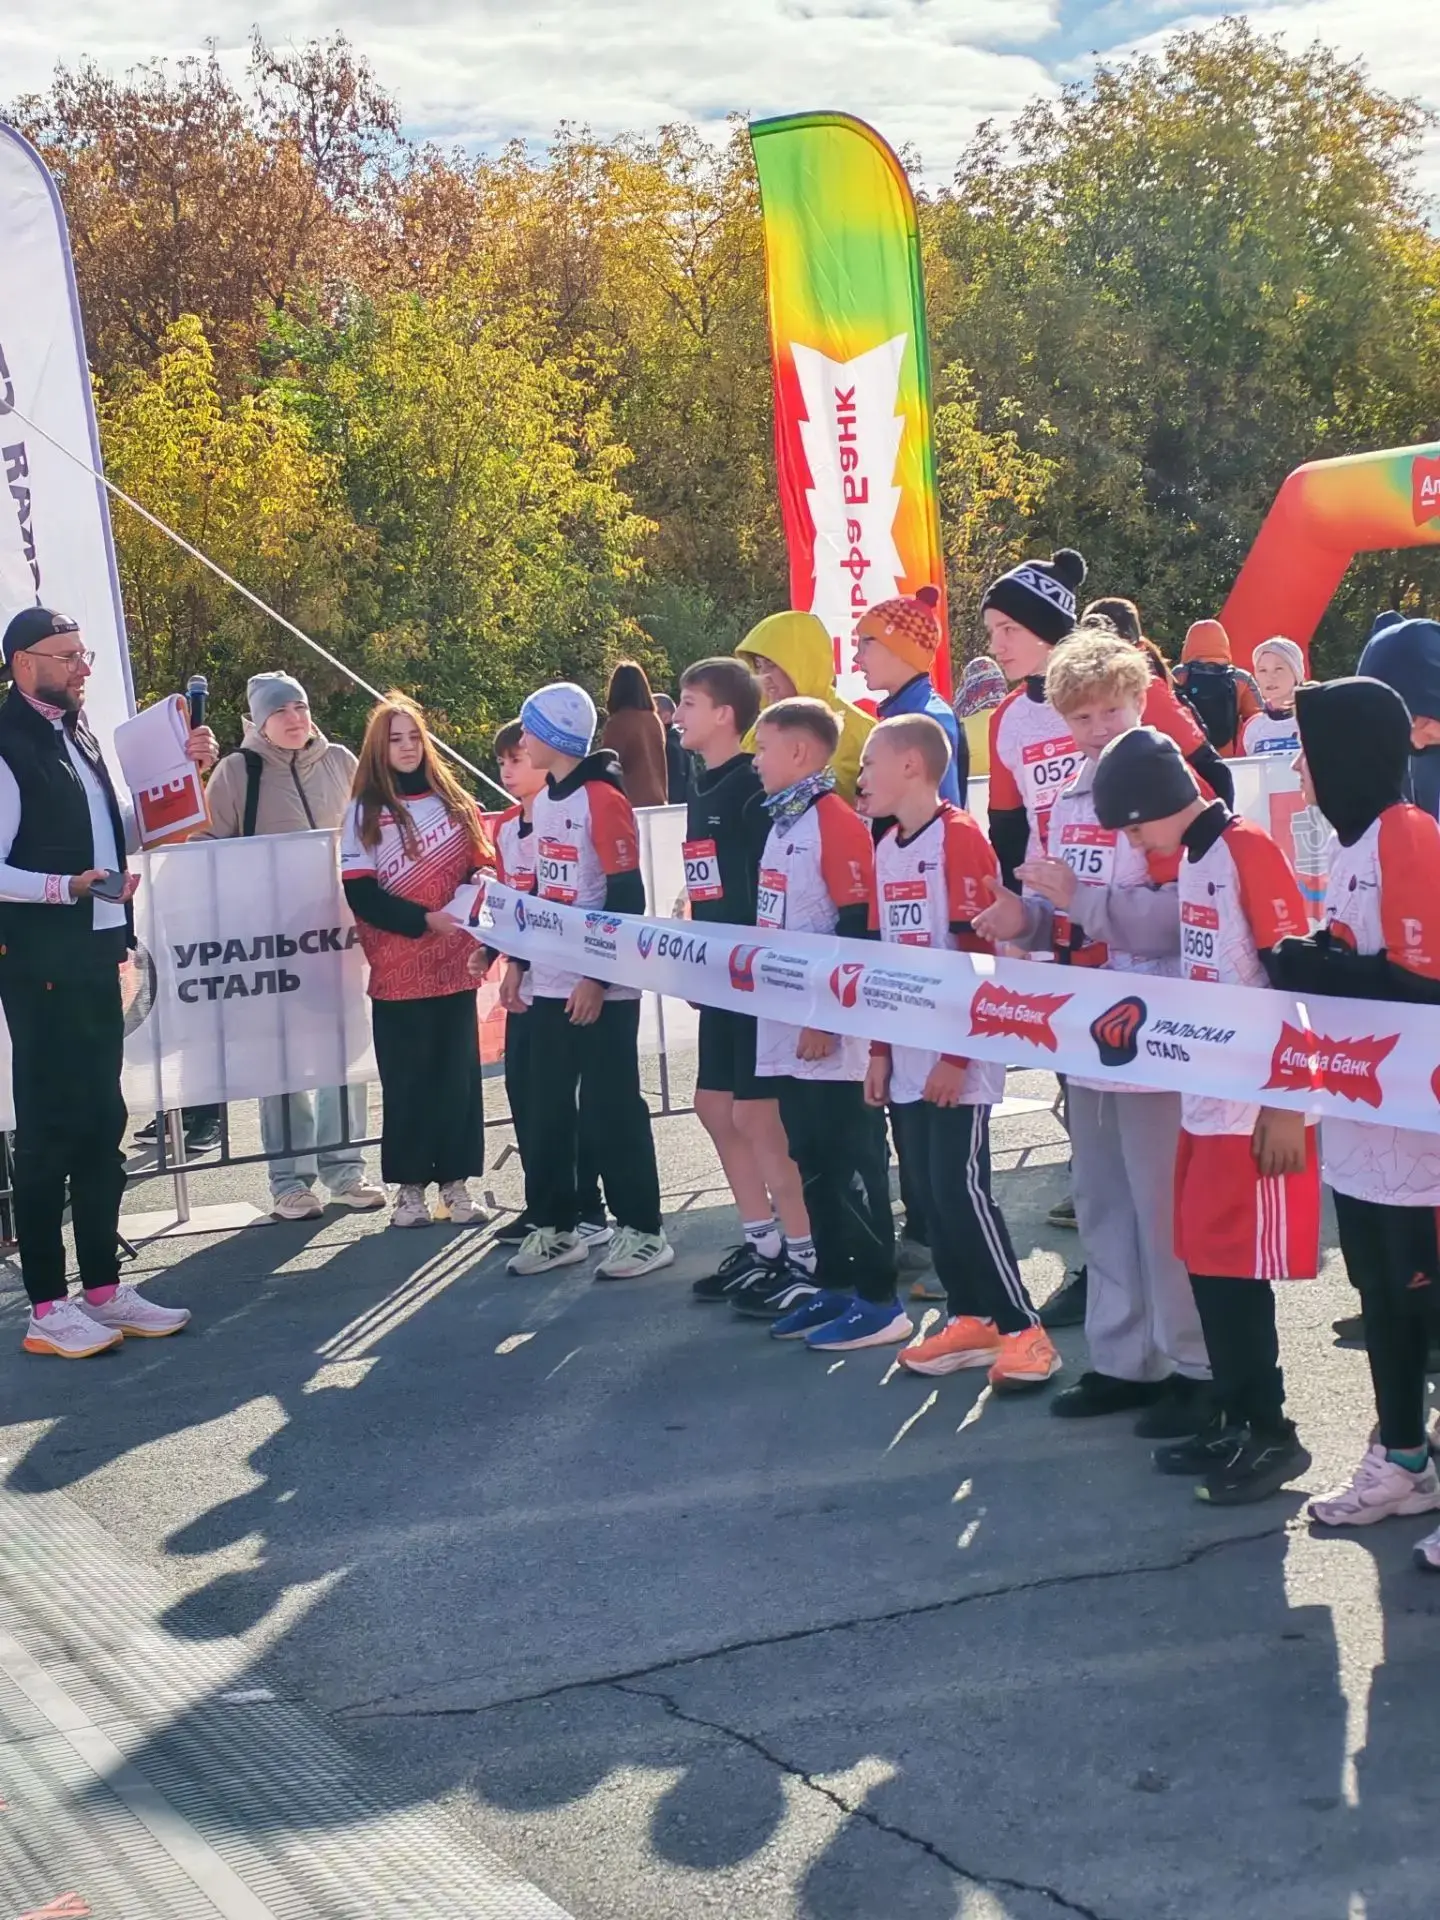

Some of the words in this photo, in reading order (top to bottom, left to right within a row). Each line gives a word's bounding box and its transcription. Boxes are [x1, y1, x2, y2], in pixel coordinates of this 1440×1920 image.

[657, 934, 708, 966] ВФЛА
[177, 968, 301, 1004] СТАЛЬ
[1149, 1019, 1236, 1044] УРАЛЬСКАЯ
[1146, 1040, 1190, 1062] СТАЛЬ
[1331, 1053, 1371, 1077] Банк
